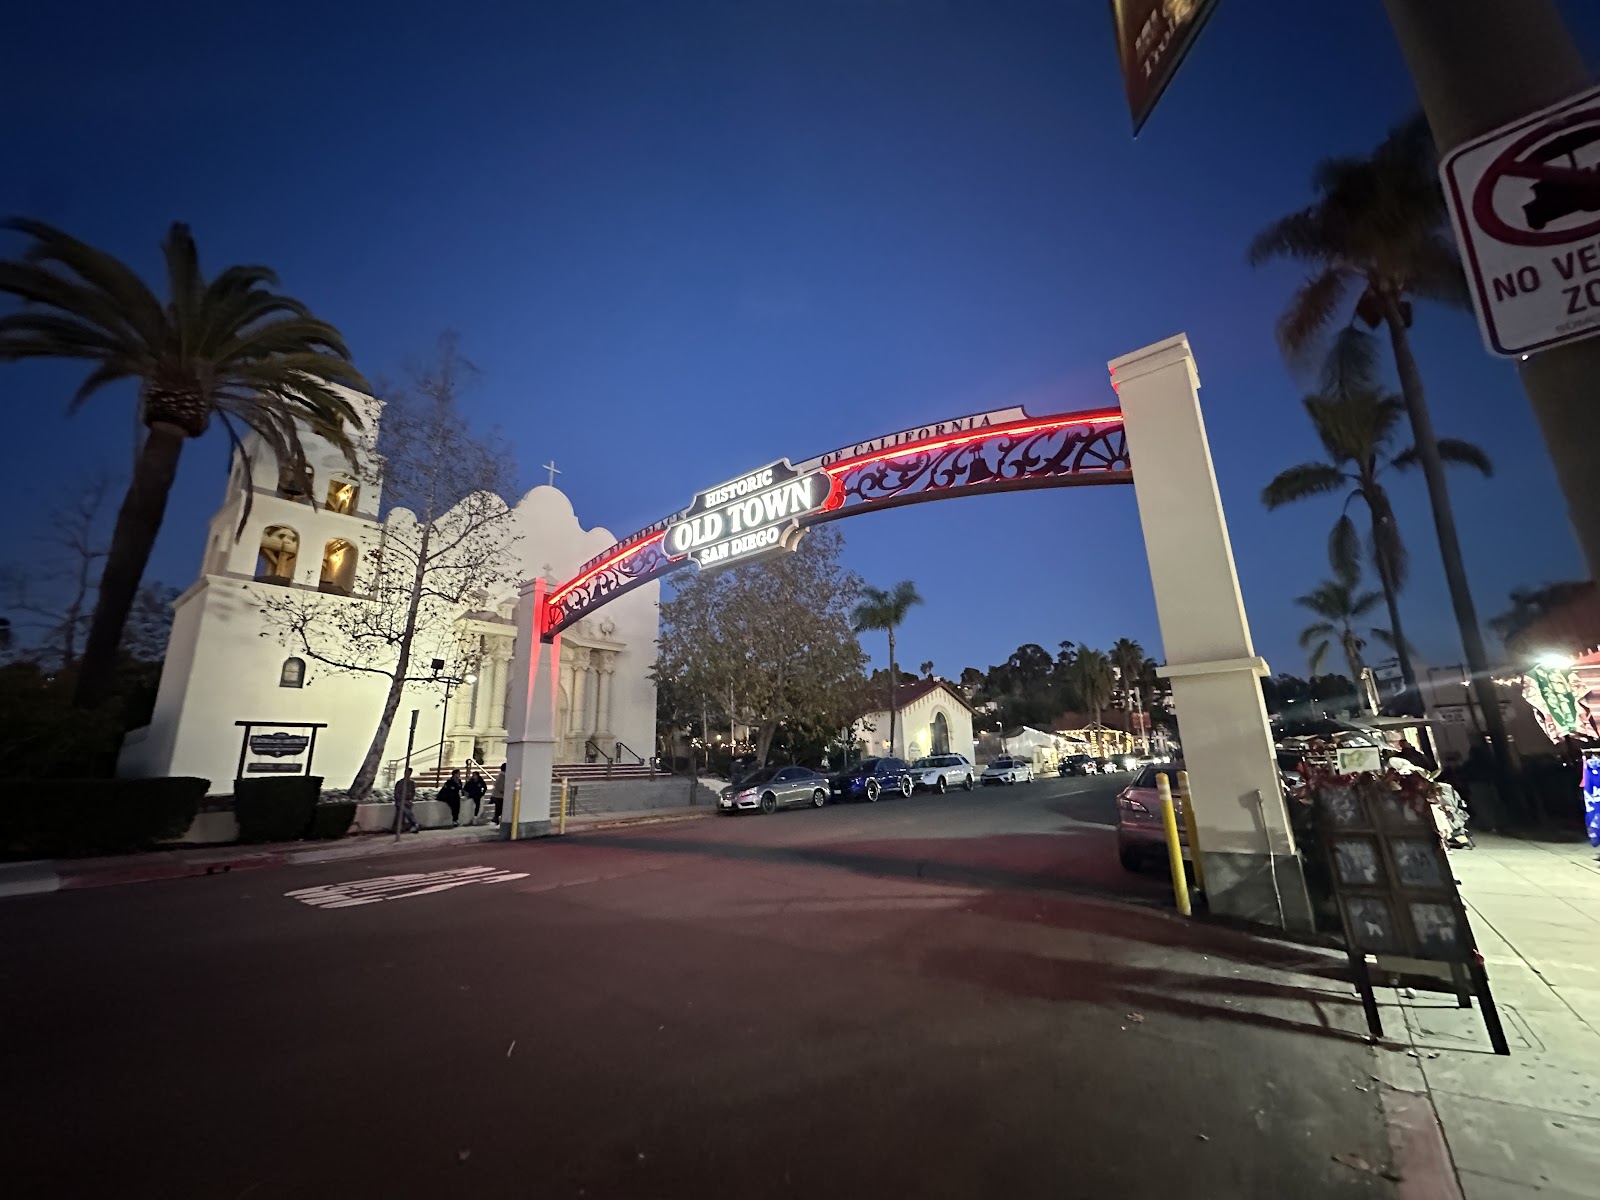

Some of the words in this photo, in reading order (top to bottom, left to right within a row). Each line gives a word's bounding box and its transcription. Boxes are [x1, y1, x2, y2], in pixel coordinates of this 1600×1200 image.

[1492, 265, 1540, 302] NO
[1552, 243, 1600, 280] VE
[820, 450, 843, 467] OF
[853, 414, 992, 457] CALIFORNIA
[705, 469, 773, 508] HISTORIC
[674, 512, 723, 551] OLD
[727, 477, 812, 534] TOWN
[701, 544, 730, 565] SAN
[731, 526, 779, 556] DIEGO
[283, 865, 531, 909] STOP
